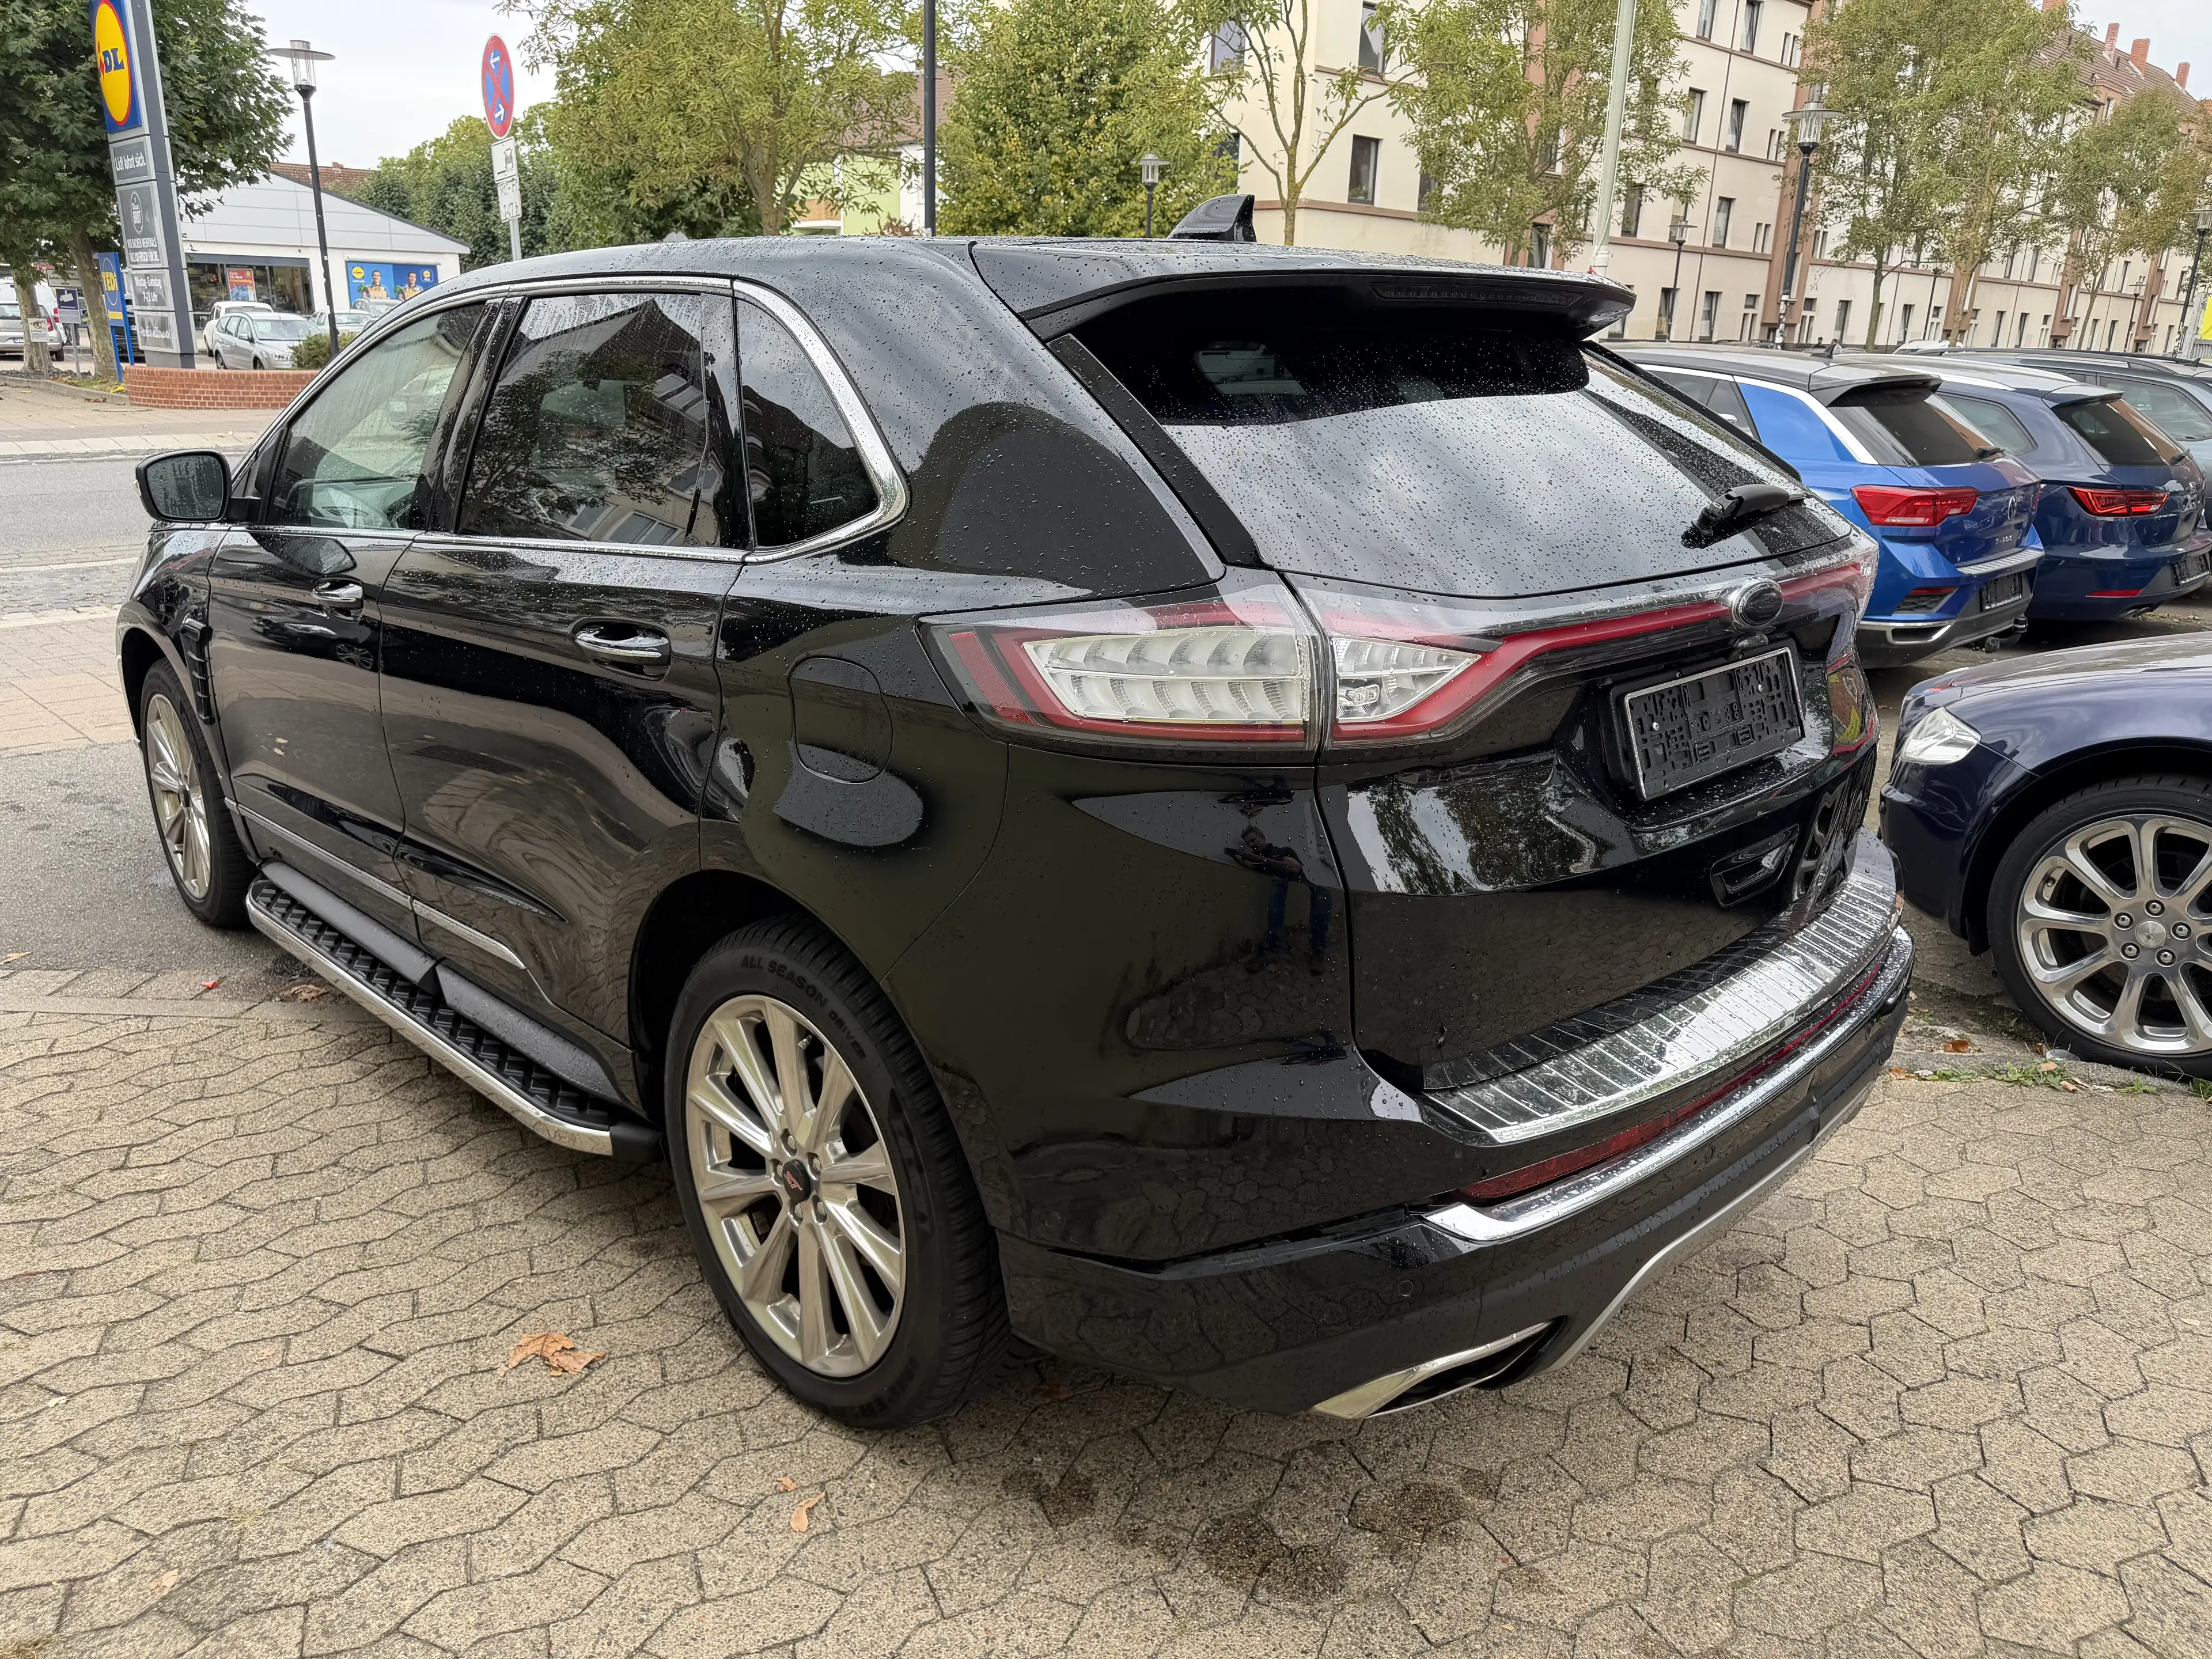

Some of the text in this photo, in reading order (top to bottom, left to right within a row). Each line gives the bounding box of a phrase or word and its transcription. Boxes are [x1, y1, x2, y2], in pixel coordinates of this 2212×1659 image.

[115, 152, 146, 171] Lidl lohnt sich.
[741, 955, 866, 1060] ALL SEASON DRIVER
[783, 1171, 803, 1191] ST
